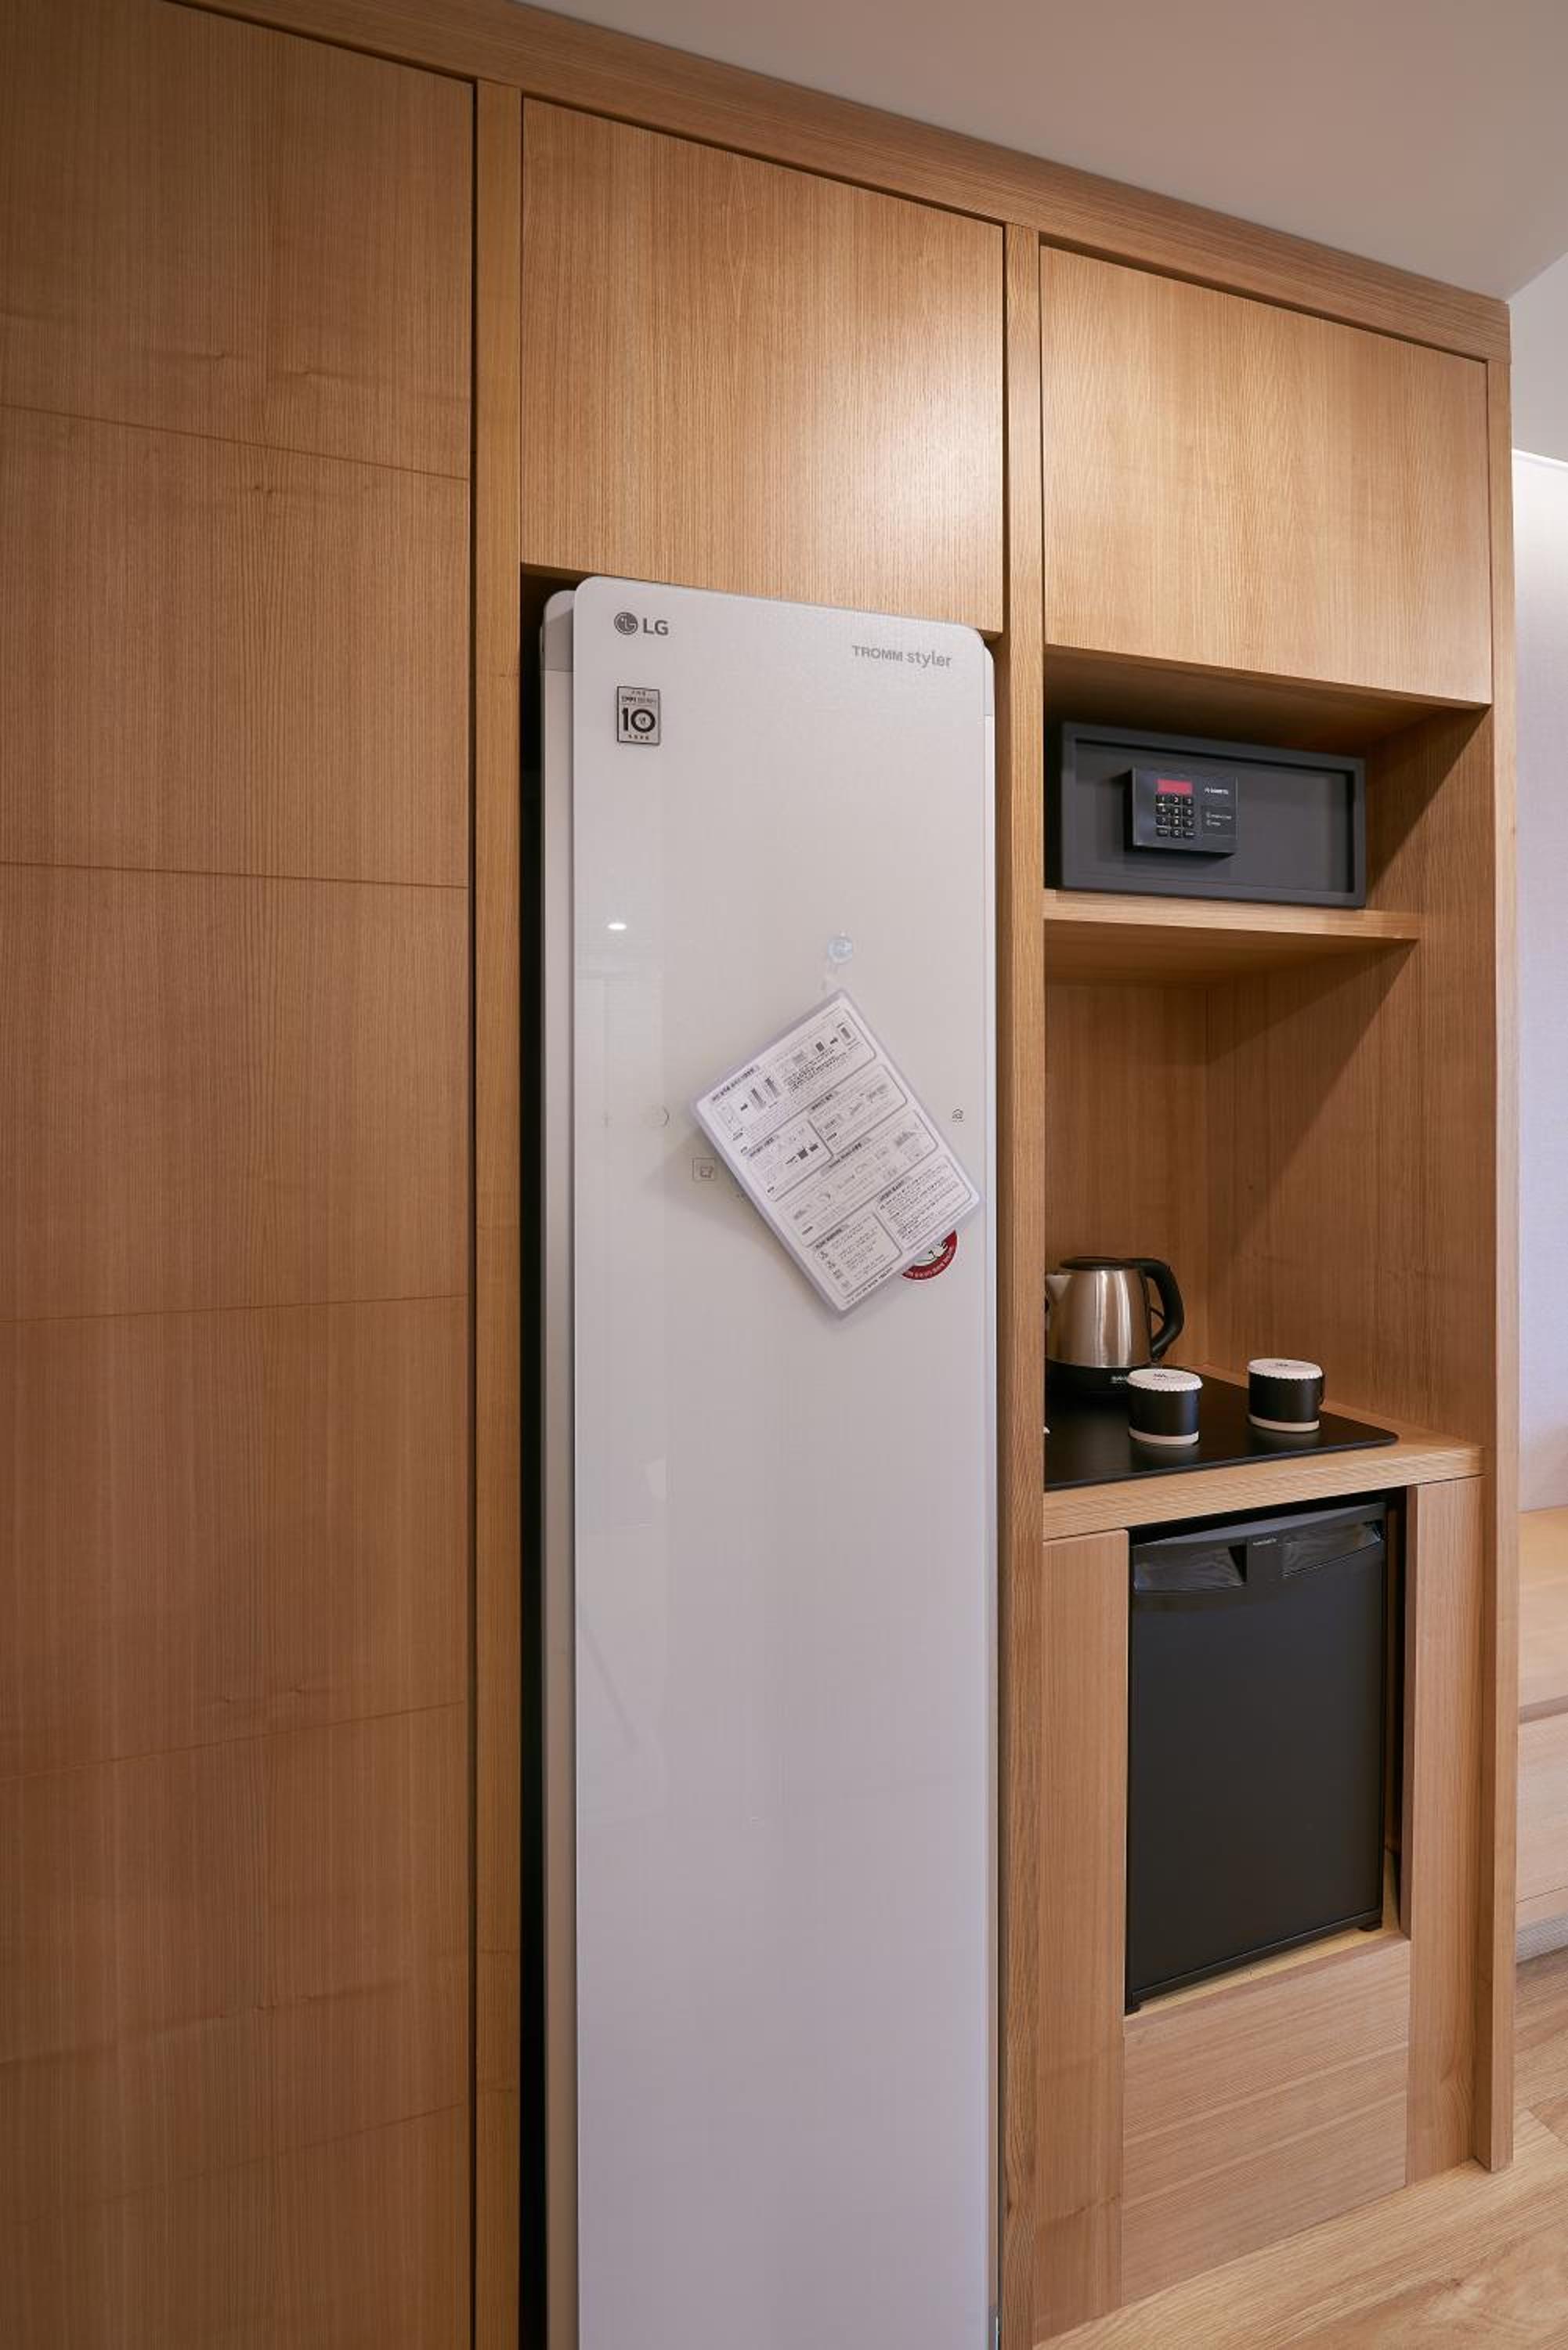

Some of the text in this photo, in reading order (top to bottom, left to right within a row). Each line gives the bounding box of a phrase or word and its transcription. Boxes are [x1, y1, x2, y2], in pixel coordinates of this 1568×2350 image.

[643, 618, 669, 636] LG
[851, 645, 952, 668] TROMM styler
[622, 707, 656, 733] 10
